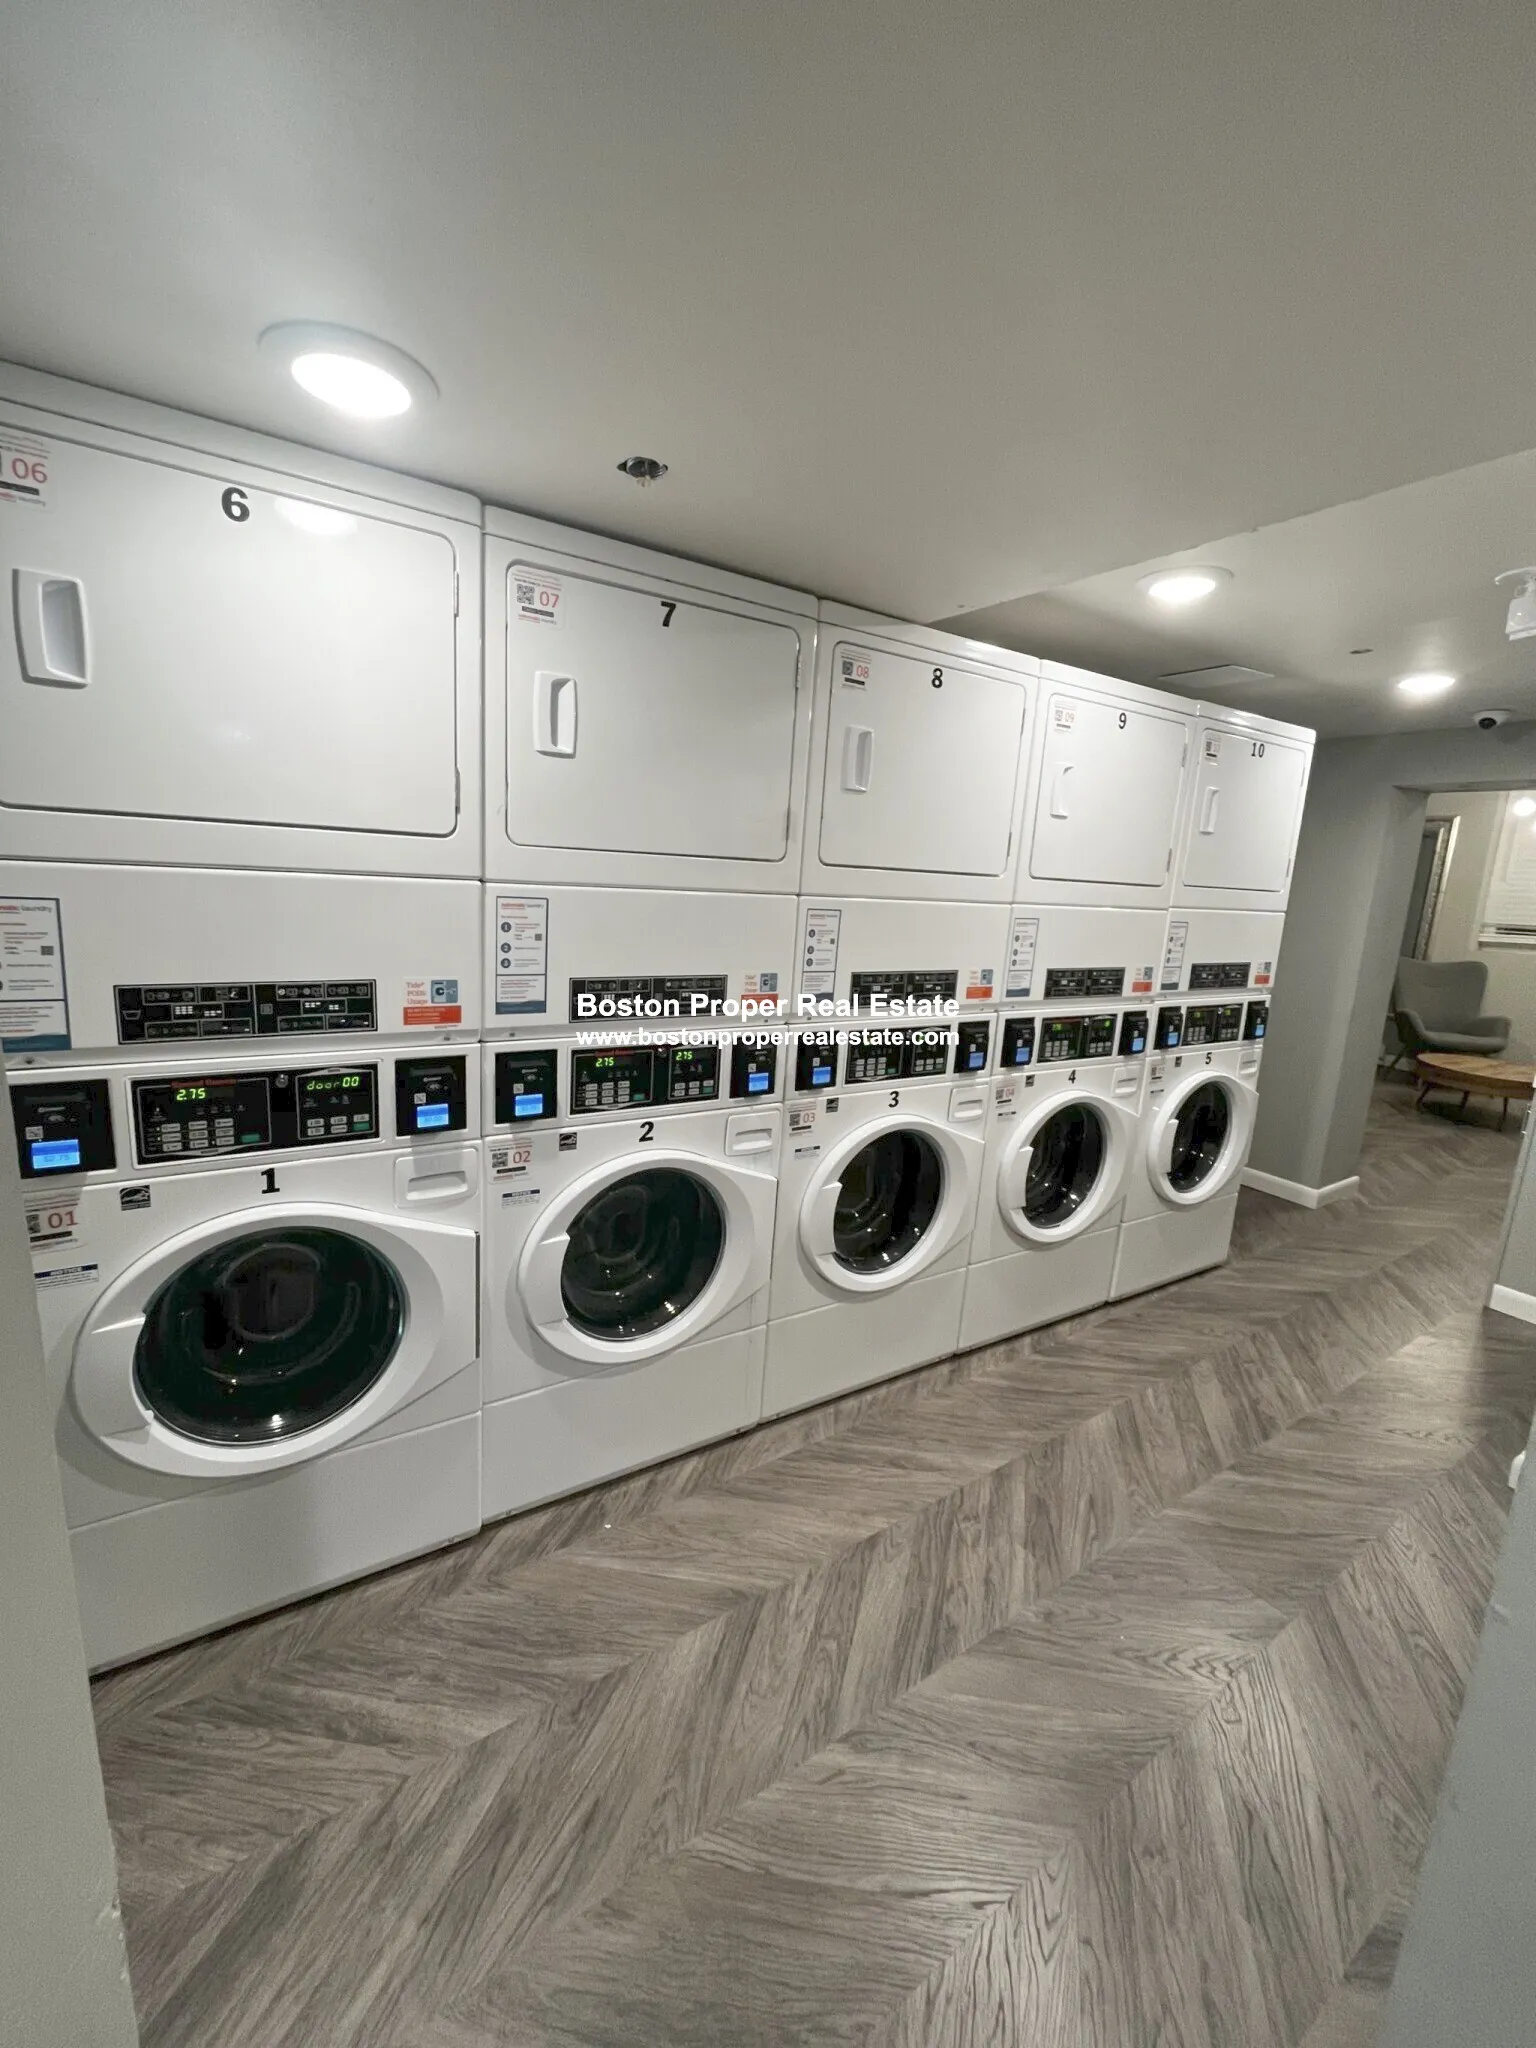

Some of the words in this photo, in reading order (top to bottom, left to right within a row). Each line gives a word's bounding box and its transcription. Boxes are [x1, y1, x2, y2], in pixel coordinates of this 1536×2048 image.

[11, 458, 48, 484] 06
[221, 487, 250, 522] 6
[540, 591, 560, 608] 07
[660, 601, 677, 627] 7
[932, 668, 943, 688] 8
[1118, 712, 1127, 729] 9
[1251, 742, 1265, 758] 10
[1205, 1051, 1212, 1065] 5
[1068, 1069, 1076, 1083] 4
[176, 1088, 206, 1101] 2.75
[888, 1091, 899, 1108] 3
[638, 1121, 655, 1142] 2
[513, 1150, 531, 1164] 02
[261, 1168, 280, 1194] 1
[47, 1210, 79, 1229] 01
